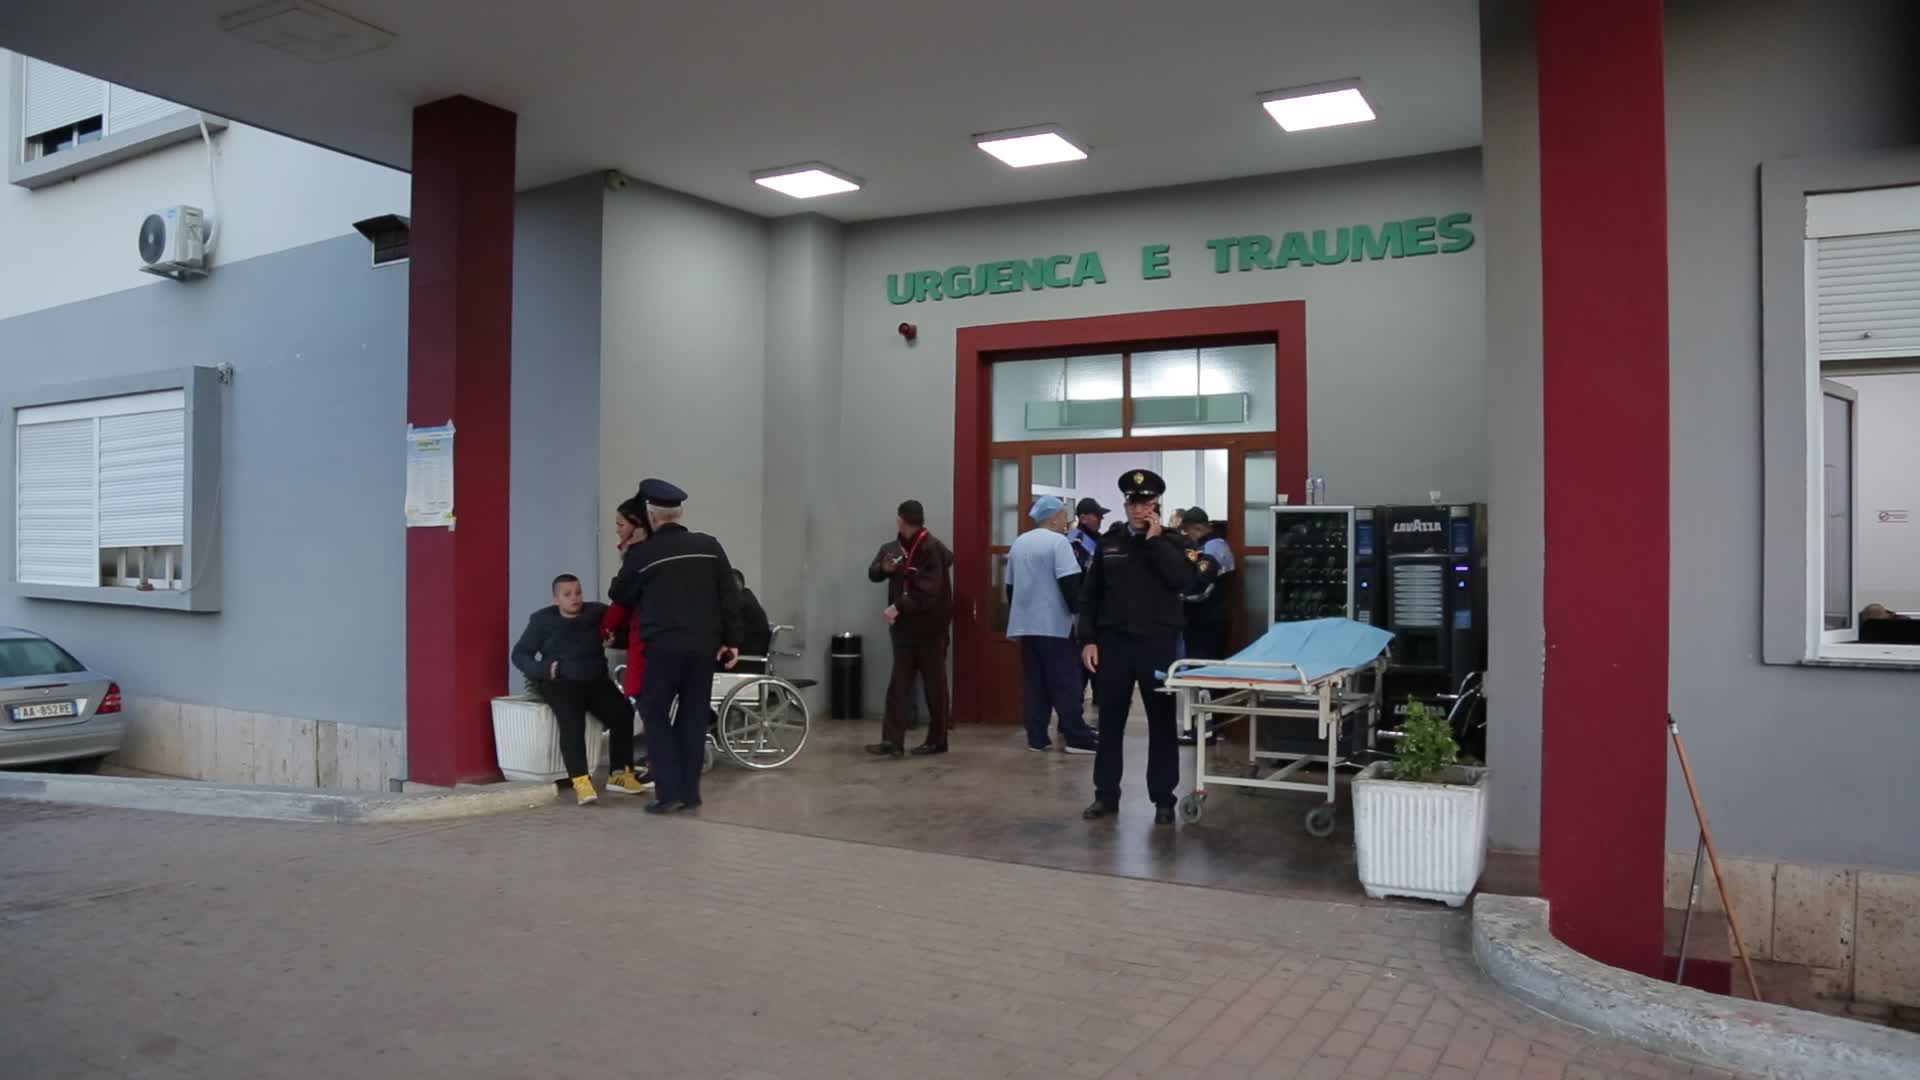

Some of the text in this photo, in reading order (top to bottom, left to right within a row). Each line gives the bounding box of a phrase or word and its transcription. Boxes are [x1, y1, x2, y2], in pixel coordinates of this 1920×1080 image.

[886, 212, 1475, 304] URGJENCA E TRAUMES
[1393, 519, 1443, 532] LAVAZZA
